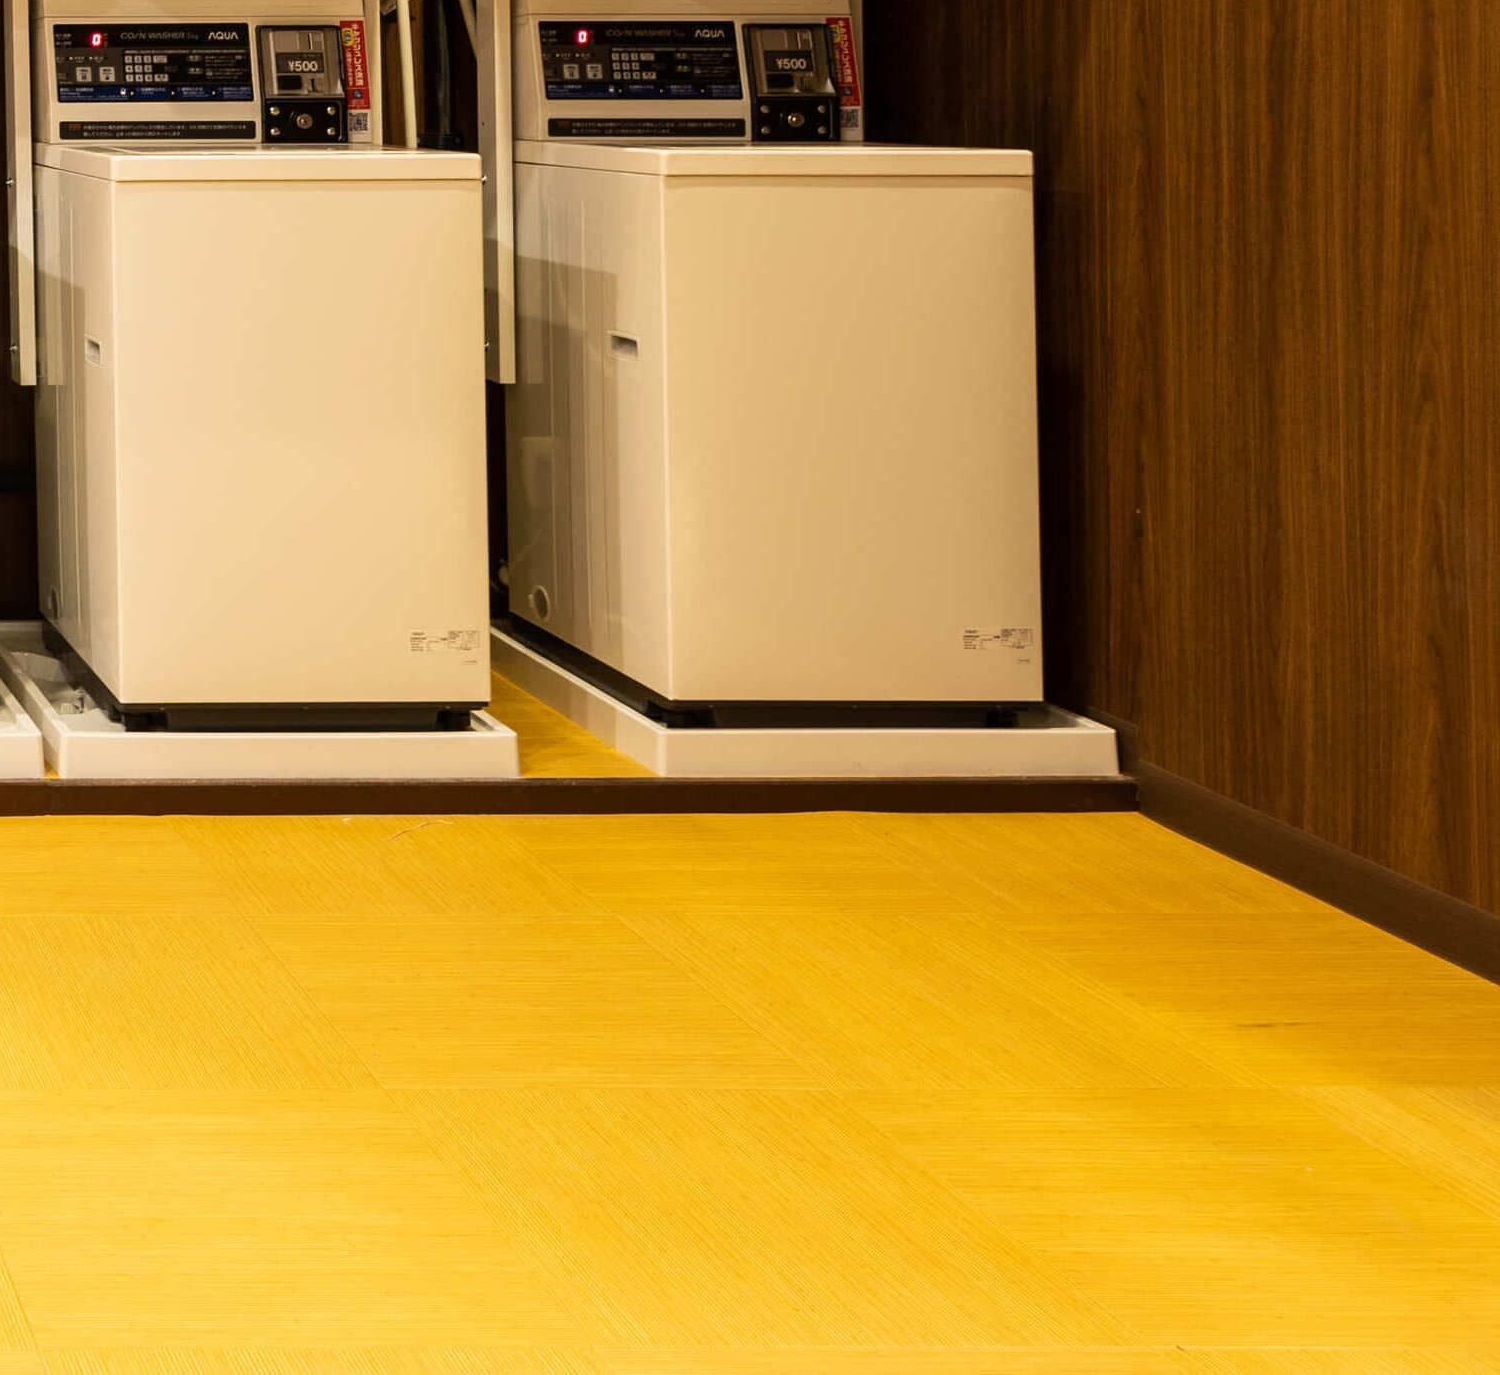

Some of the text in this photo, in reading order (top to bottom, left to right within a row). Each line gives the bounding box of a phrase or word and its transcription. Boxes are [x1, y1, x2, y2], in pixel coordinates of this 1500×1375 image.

[92, 33, 102, 46] 0
[208, 31, 238, 40] AQUA
[578, 30, 588, 43] 0
[694, 29, 725, 38] AQUA
[288, 60, 318, 72] ¥500
[775, 58, 807, 70] ¥500
